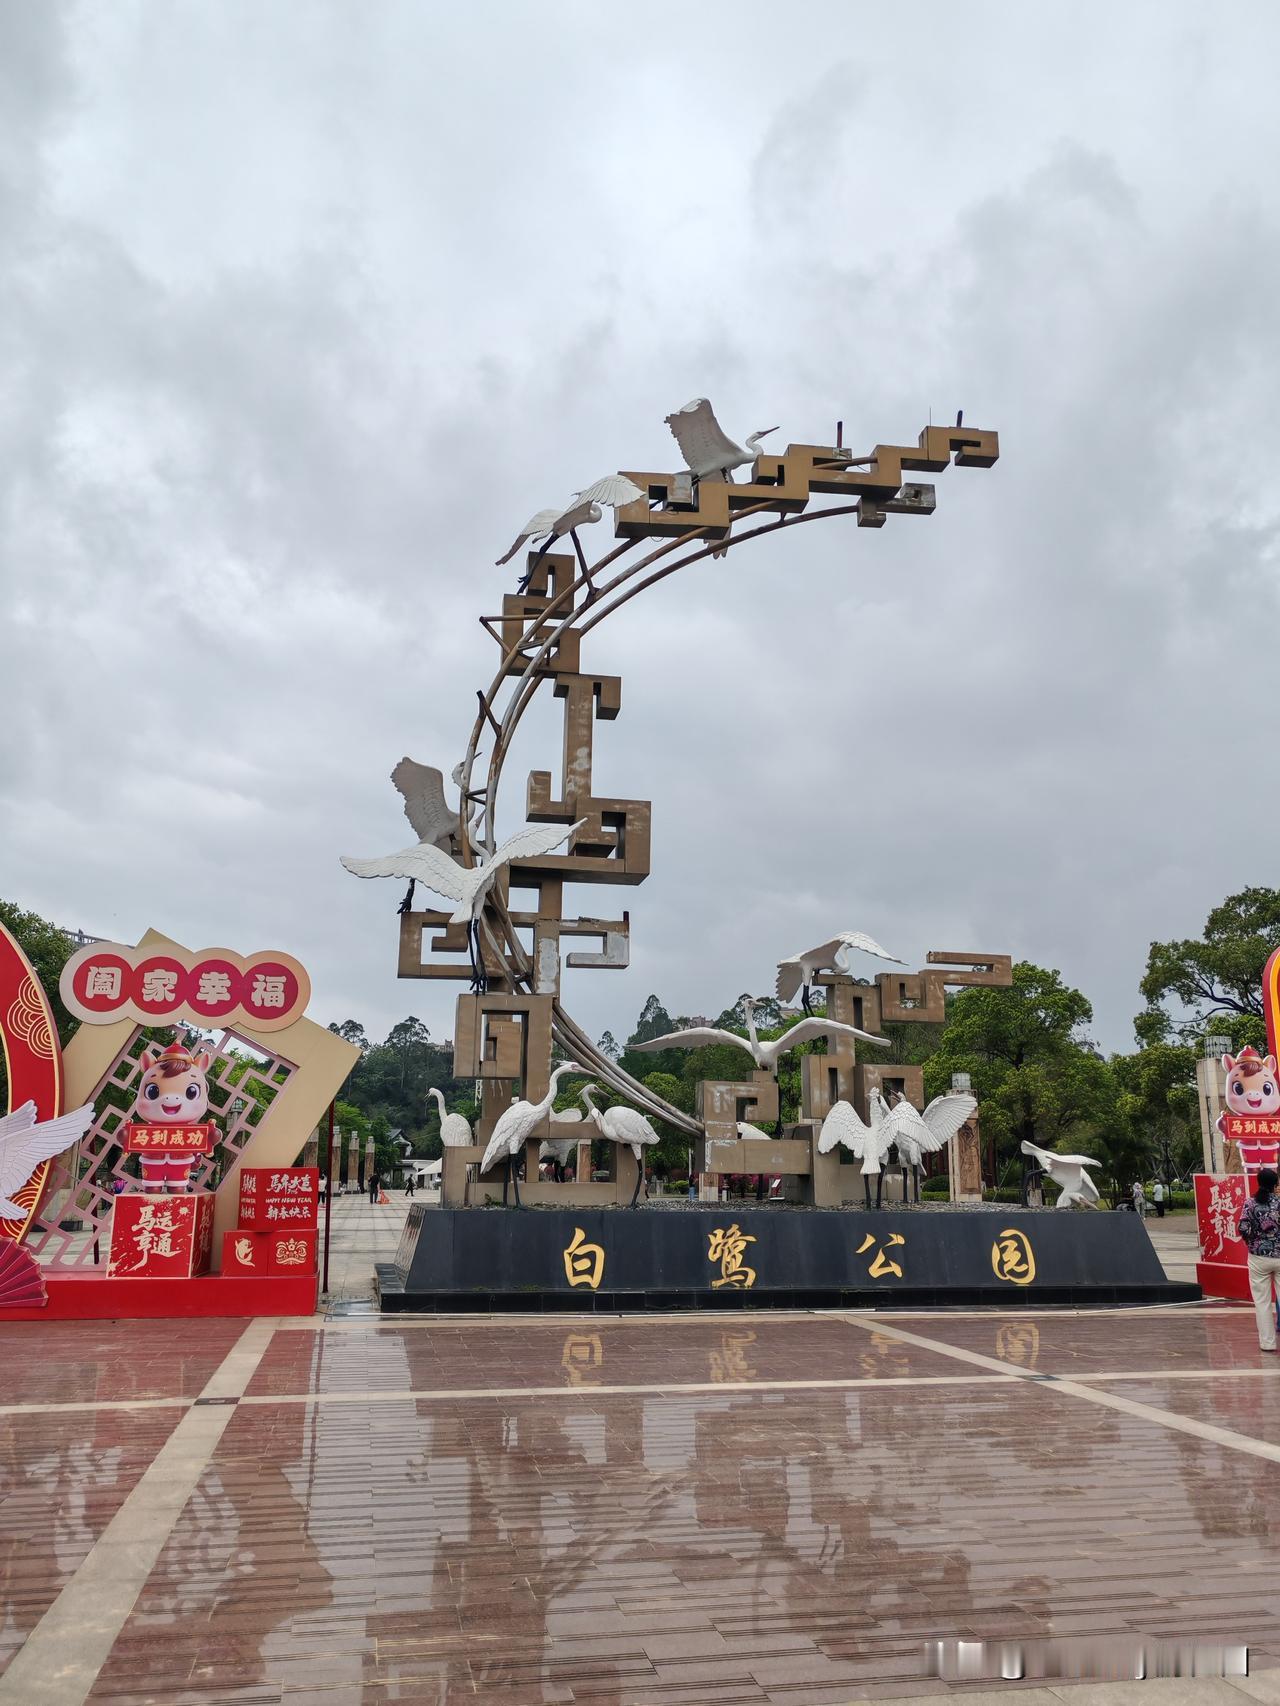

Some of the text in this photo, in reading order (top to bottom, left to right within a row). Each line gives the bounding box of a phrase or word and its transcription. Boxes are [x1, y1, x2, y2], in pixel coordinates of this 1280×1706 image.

[85, 966, 287, 1008] 阖家幸福
[133, 1129, 204, 1146] 马到成功
[265, 1205, 311, 1221] 新春快乐
